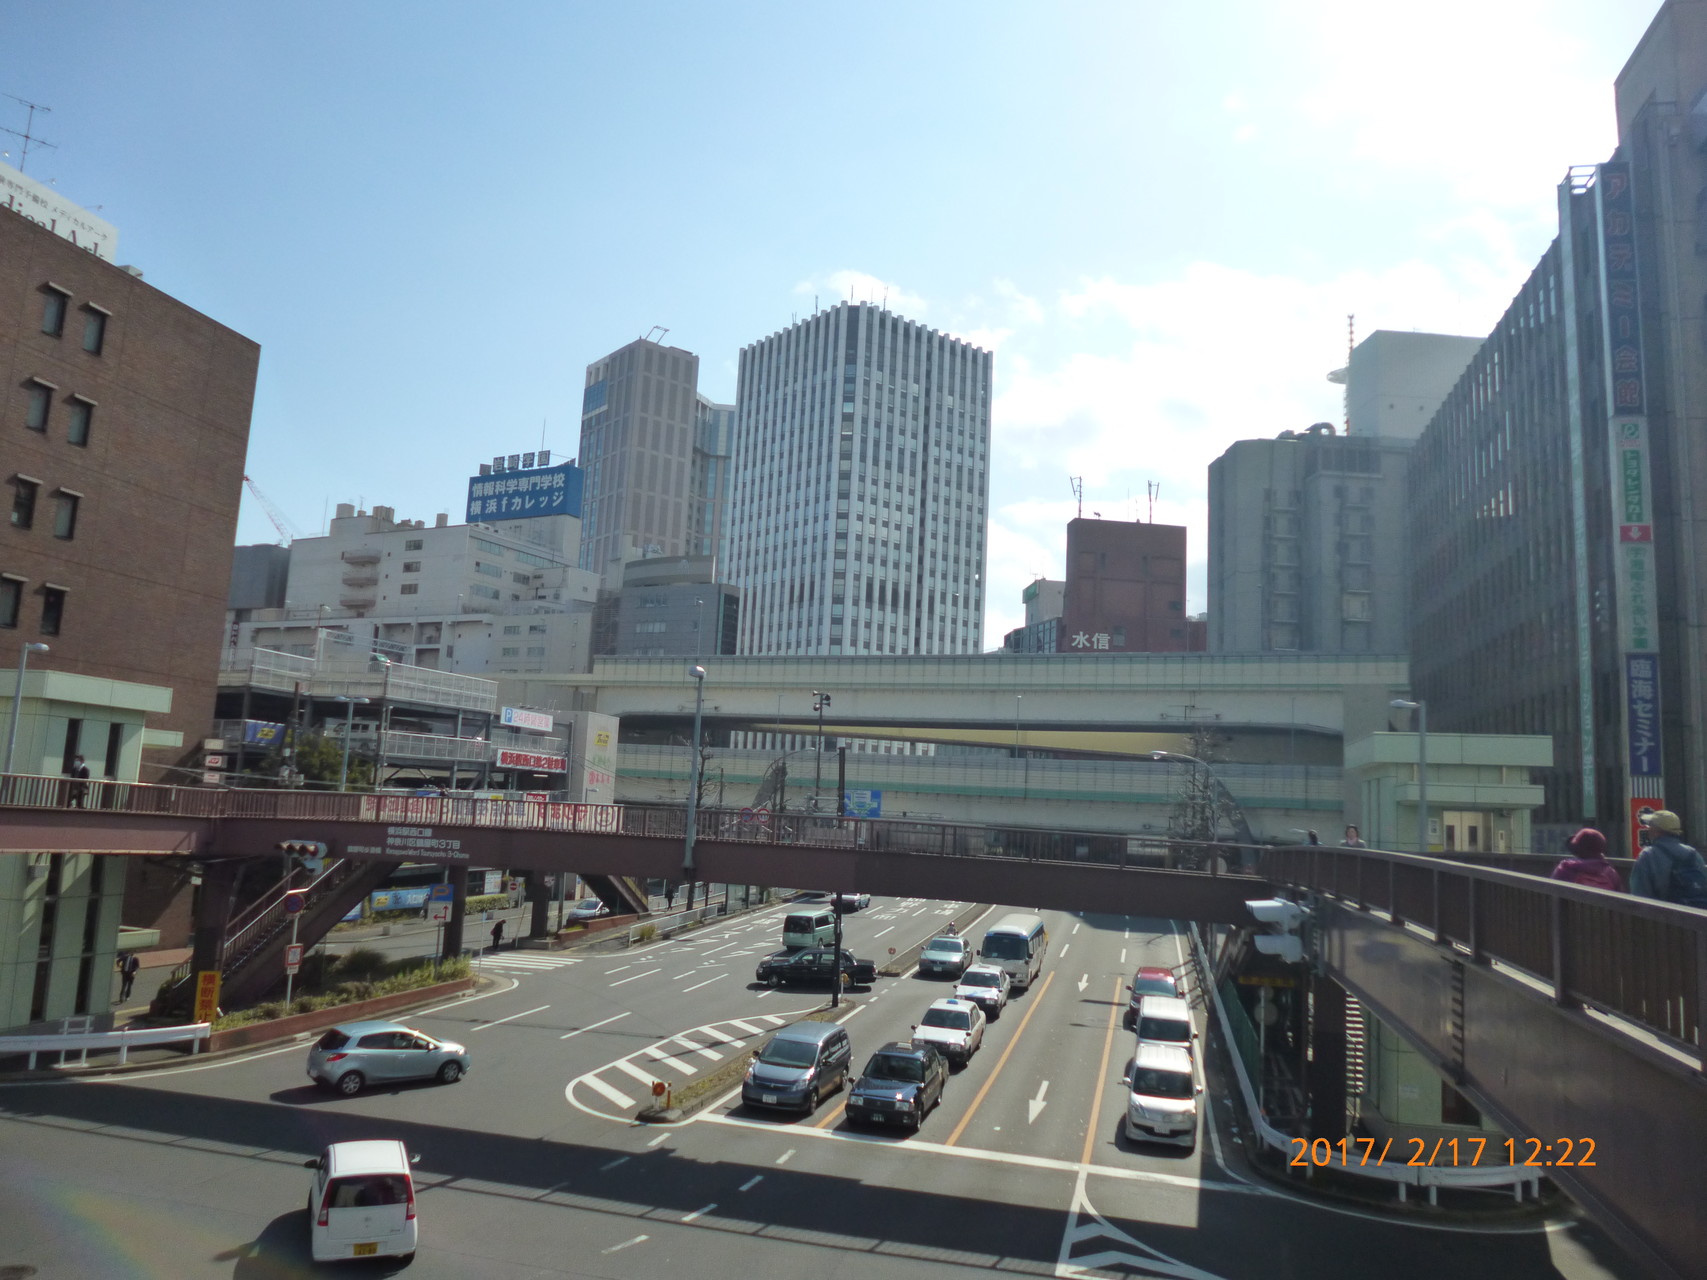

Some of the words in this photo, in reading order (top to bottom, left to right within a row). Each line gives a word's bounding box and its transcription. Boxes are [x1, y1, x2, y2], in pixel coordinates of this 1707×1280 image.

[472, 473, 565, 497] 情報科学専門学校
[1071, 631, 1111, 650] 水信
[1630, 658, 1656, 773] 臨海セミナー
